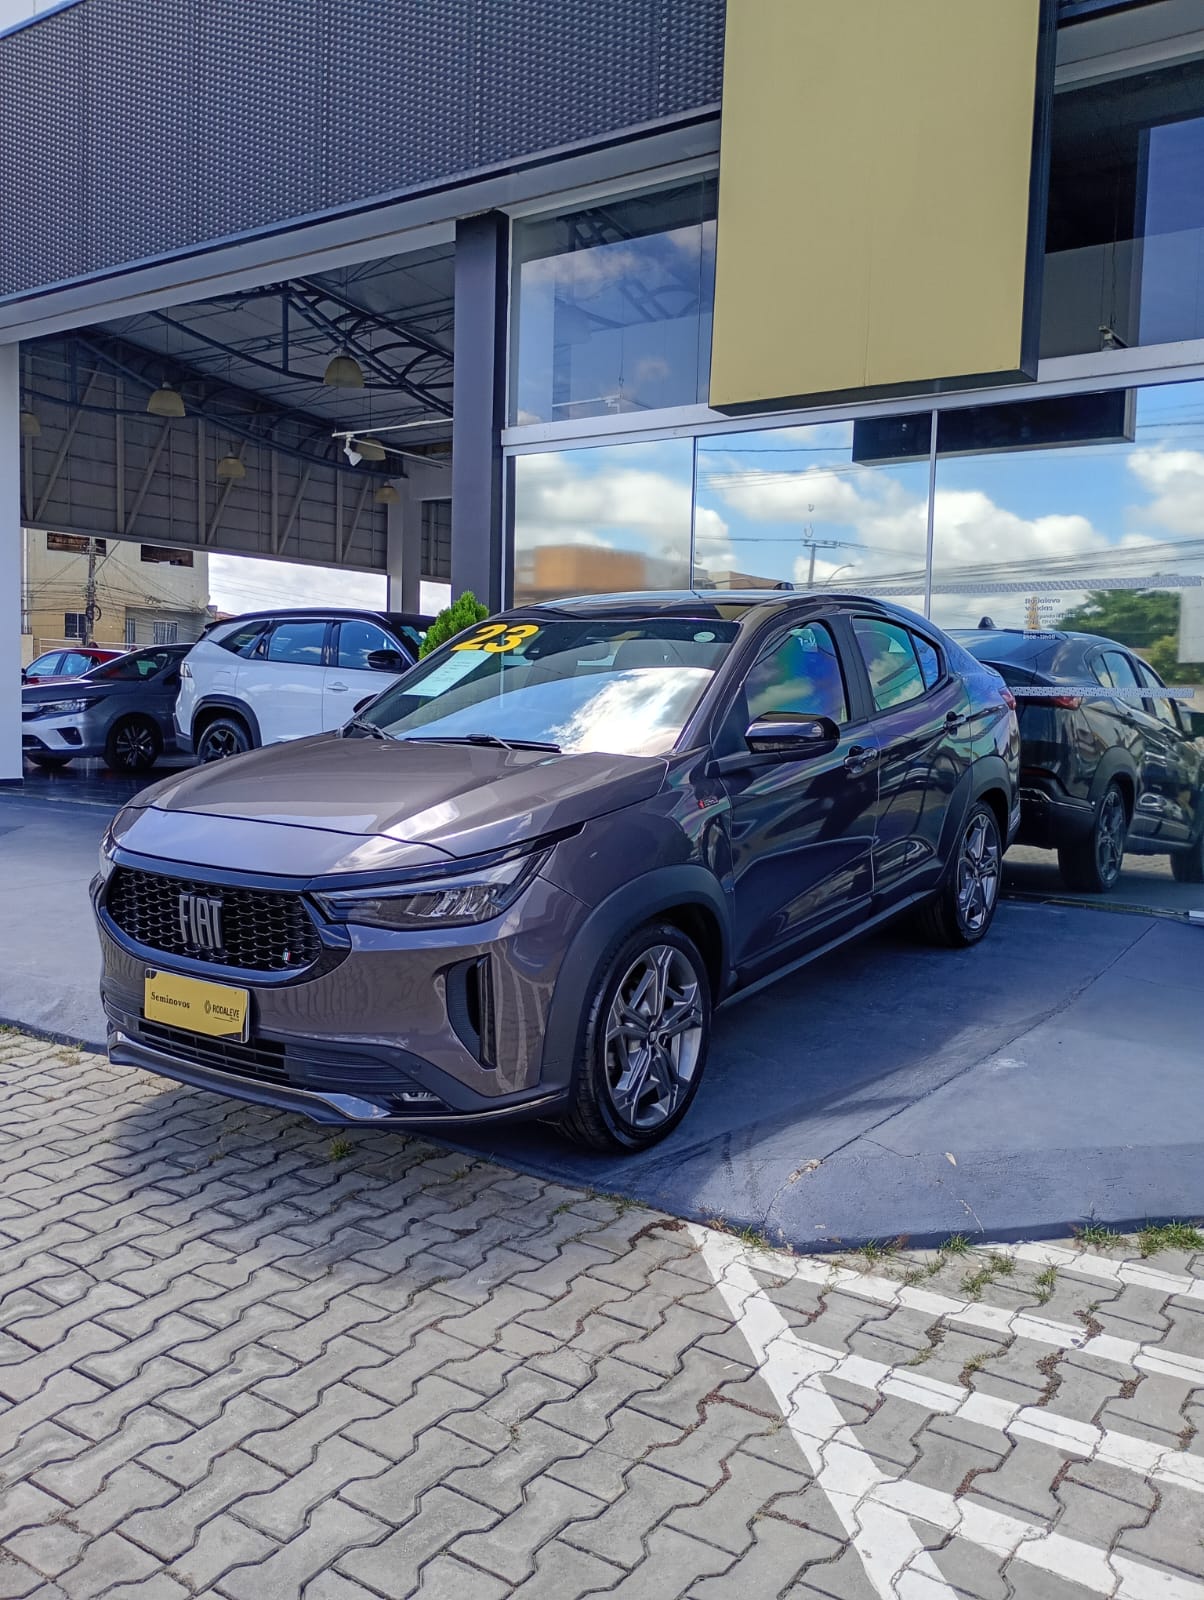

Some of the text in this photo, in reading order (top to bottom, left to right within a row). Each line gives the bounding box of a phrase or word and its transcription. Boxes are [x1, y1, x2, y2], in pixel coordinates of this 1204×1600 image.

[451, 623, 540, 653] 23
[179, 894, 223, 949] FIAT
[150, 991, 191, 1009] Seminovos
[212, 1004, 240, 1018] RODALEVE
